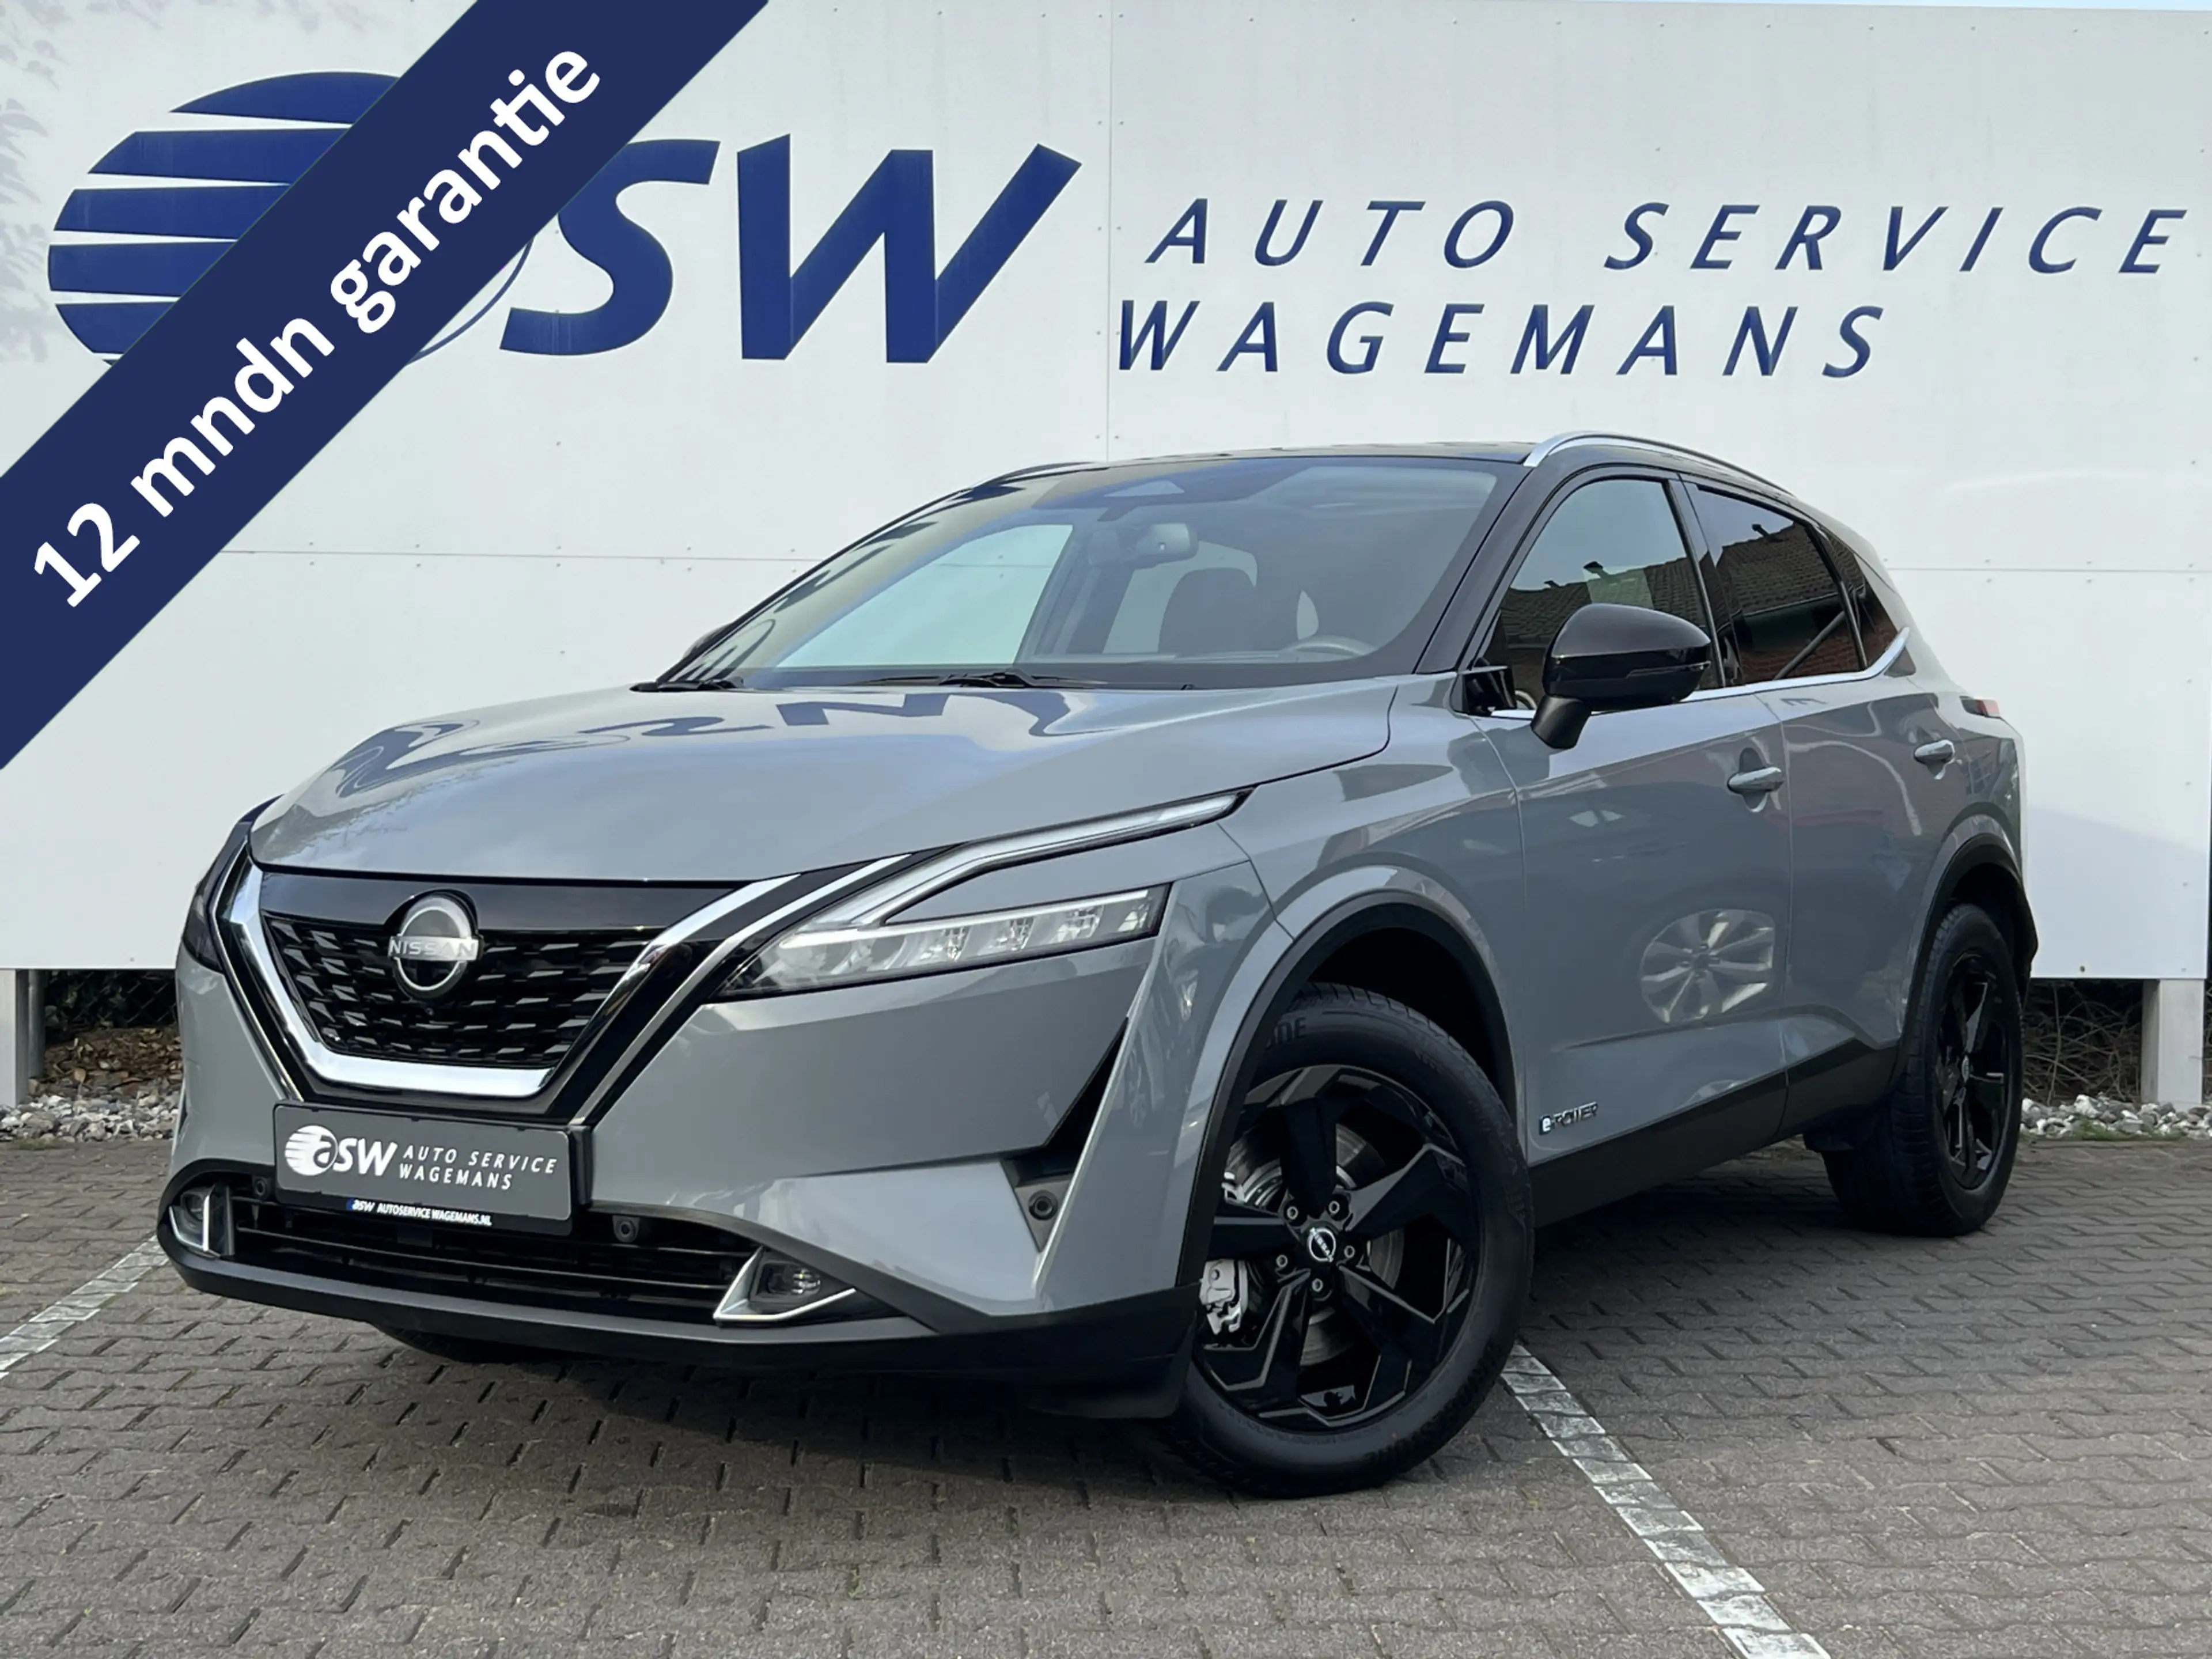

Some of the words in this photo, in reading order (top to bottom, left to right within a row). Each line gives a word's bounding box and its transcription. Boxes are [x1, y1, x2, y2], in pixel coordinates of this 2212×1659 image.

[1145, 199, 1514, 268] AUTO
[1604, 202, 2187, 274] SERVICE
[1119, 300, 1884, 378] WAGEMANS
[389, 938, 477, 958] NISSAN
[403, 1145, 457, 1164] AUTO
[468, 1151, 557, 1174] SERVICE
[399, 1163, 513, 1190] WAGEMANS
[376, 1203, 431, 1219] AUTOSERVICE
[431, 1209, 493, 1226] WAGEMANS.NL
